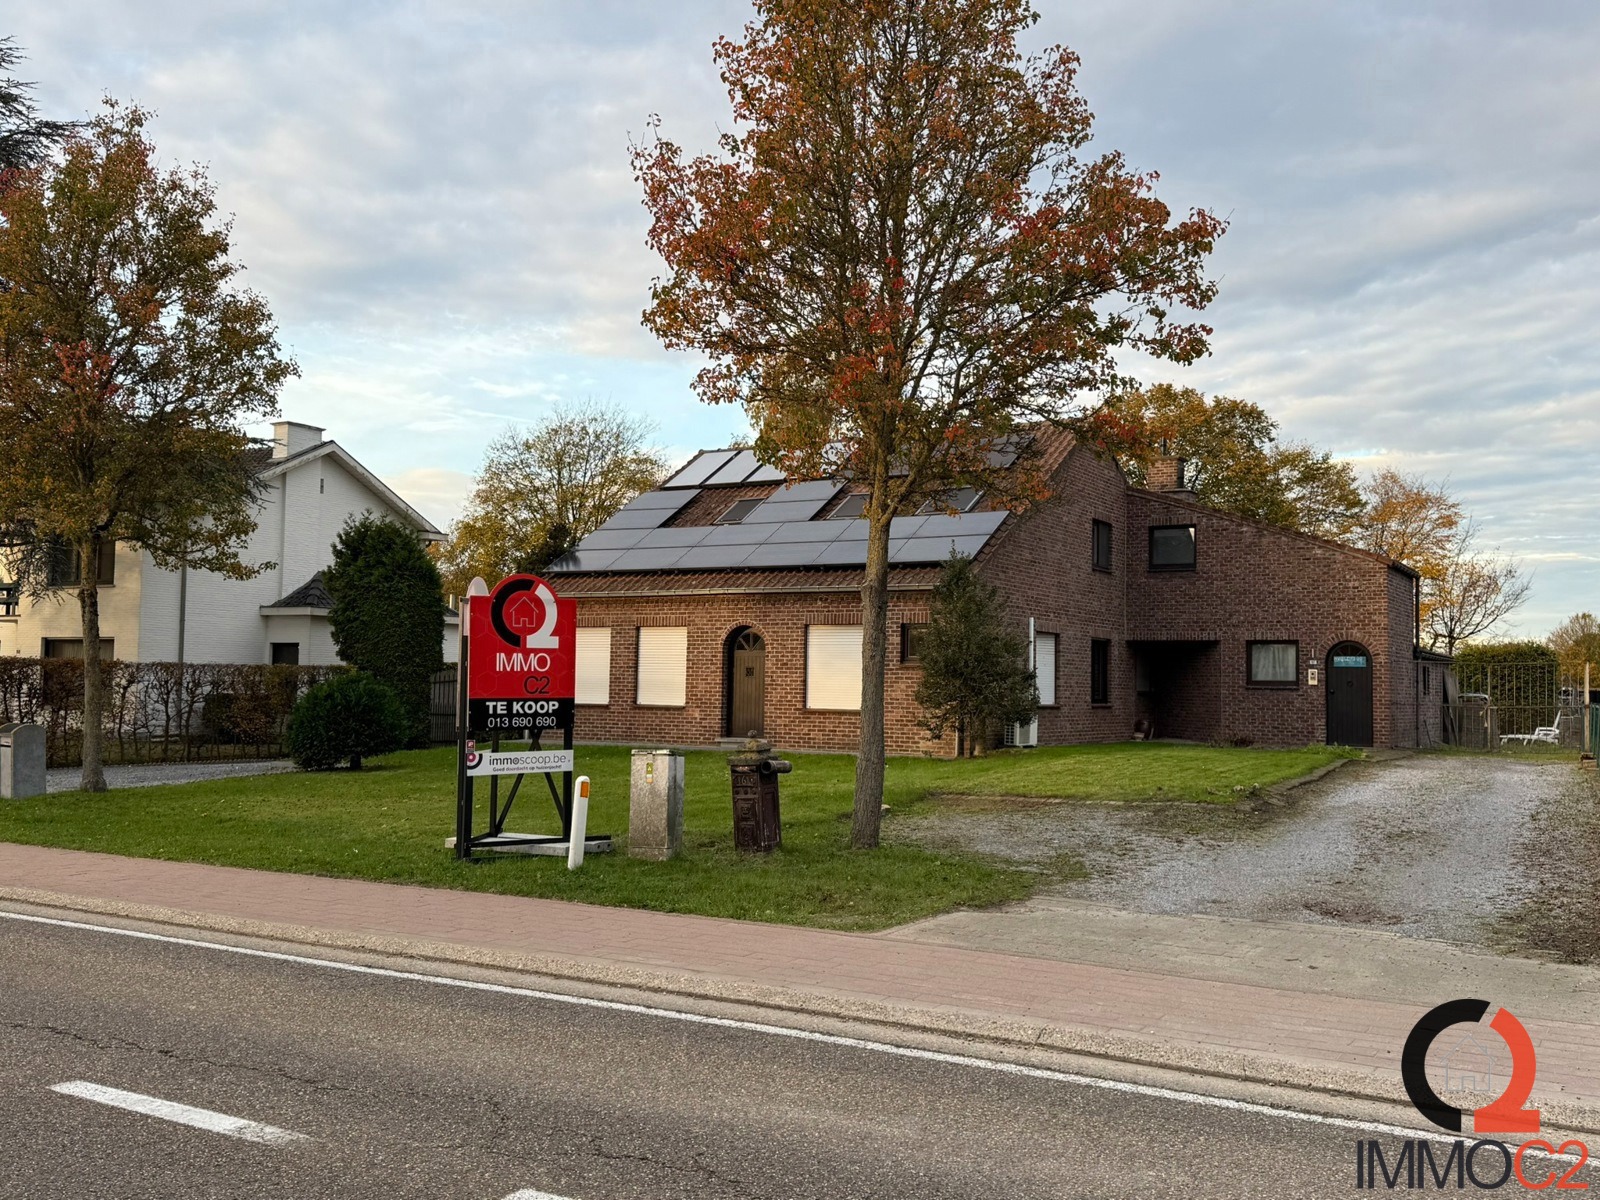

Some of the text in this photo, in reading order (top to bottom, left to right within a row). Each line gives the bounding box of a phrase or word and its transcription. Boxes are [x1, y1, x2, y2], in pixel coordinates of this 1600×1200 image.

[496, 653, 550, 672] IMMO
[524, 676, 550, 694] C2
[486, 701, 559, 714] TE KOOP
[487, 716, 557, 728] 013 690 690
[489, 753, 567, 766] immoscoop.be
